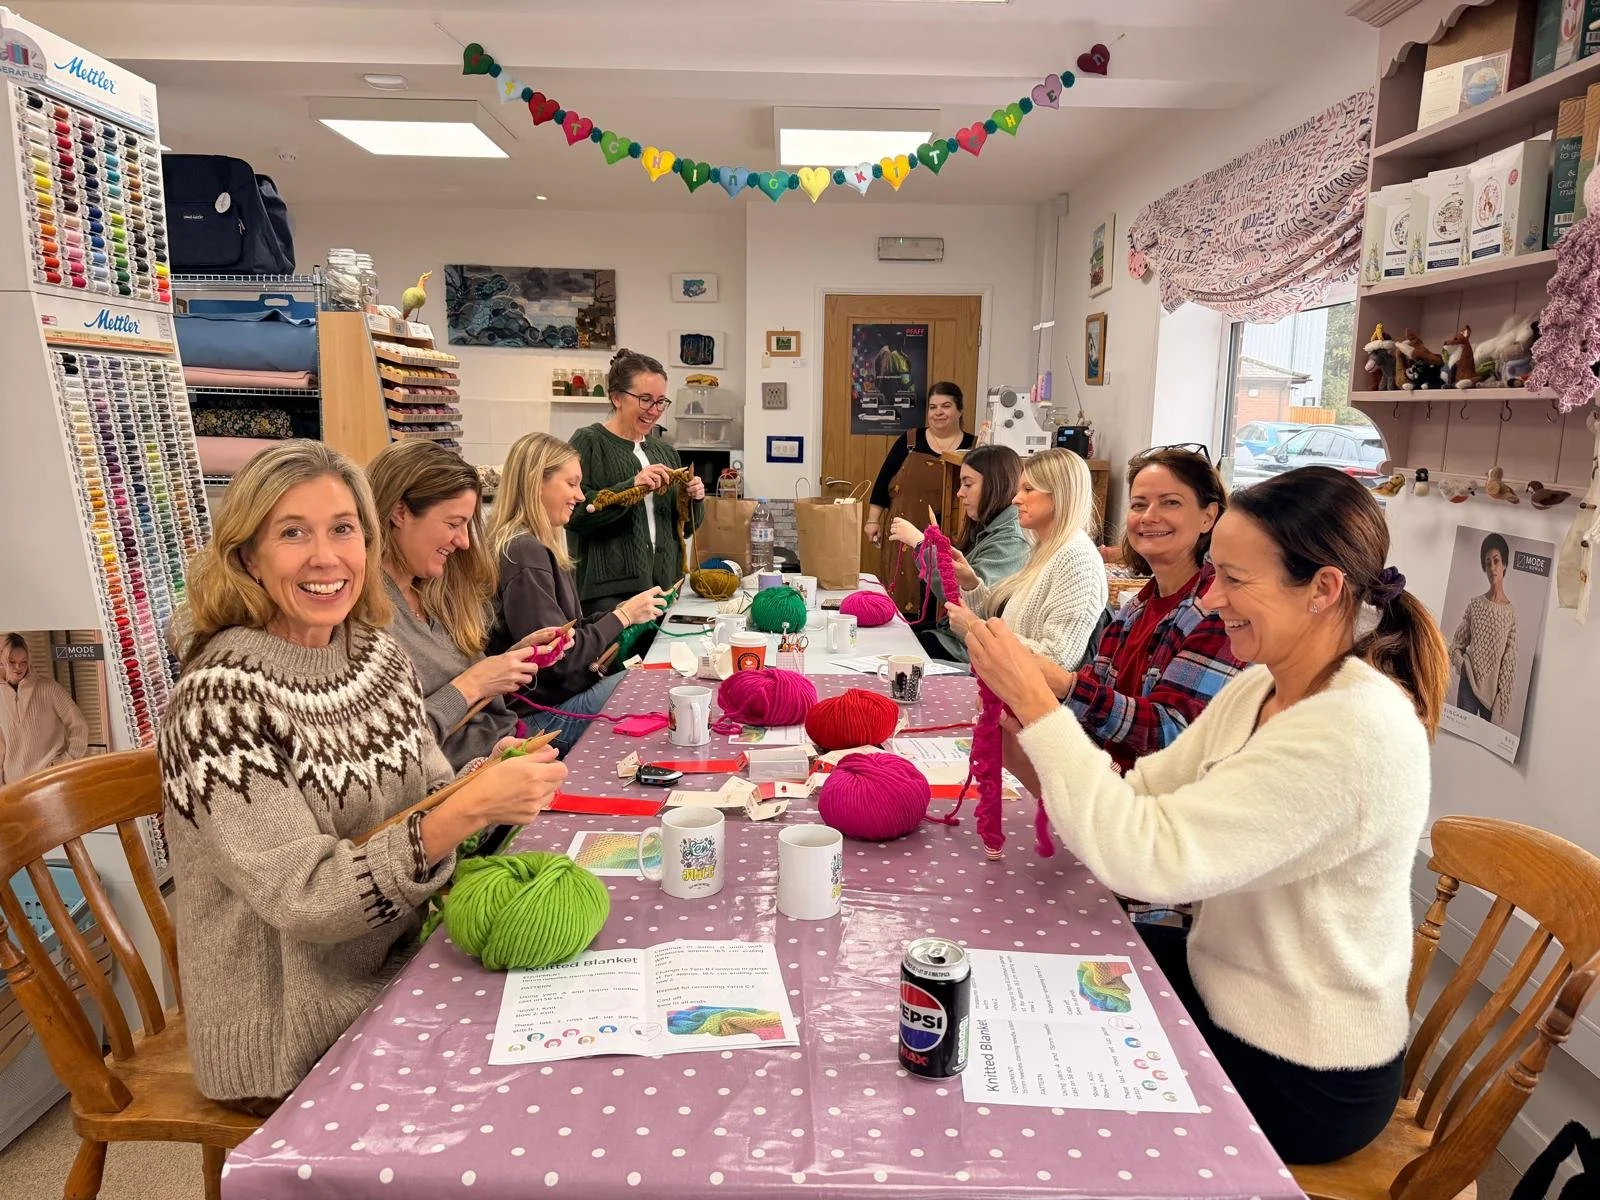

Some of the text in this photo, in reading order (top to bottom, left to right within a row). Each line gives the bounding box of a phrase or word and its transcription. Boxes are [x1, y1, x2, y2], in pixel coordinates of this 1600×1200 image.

[0, 66, 45, 82] ERAFLEX
[54, 56, 116, 95] Mettler
[84, 308, 140, 335] Mettler
[1526, 556, 1545, 568] MODE
[68, 646, 95, 654] MODE
[583, 956, 638, 968] Blanket
[900, 1005, 942, 1030] EPSI
[976, 1019, 1000, 1092] Knitted Blanket
